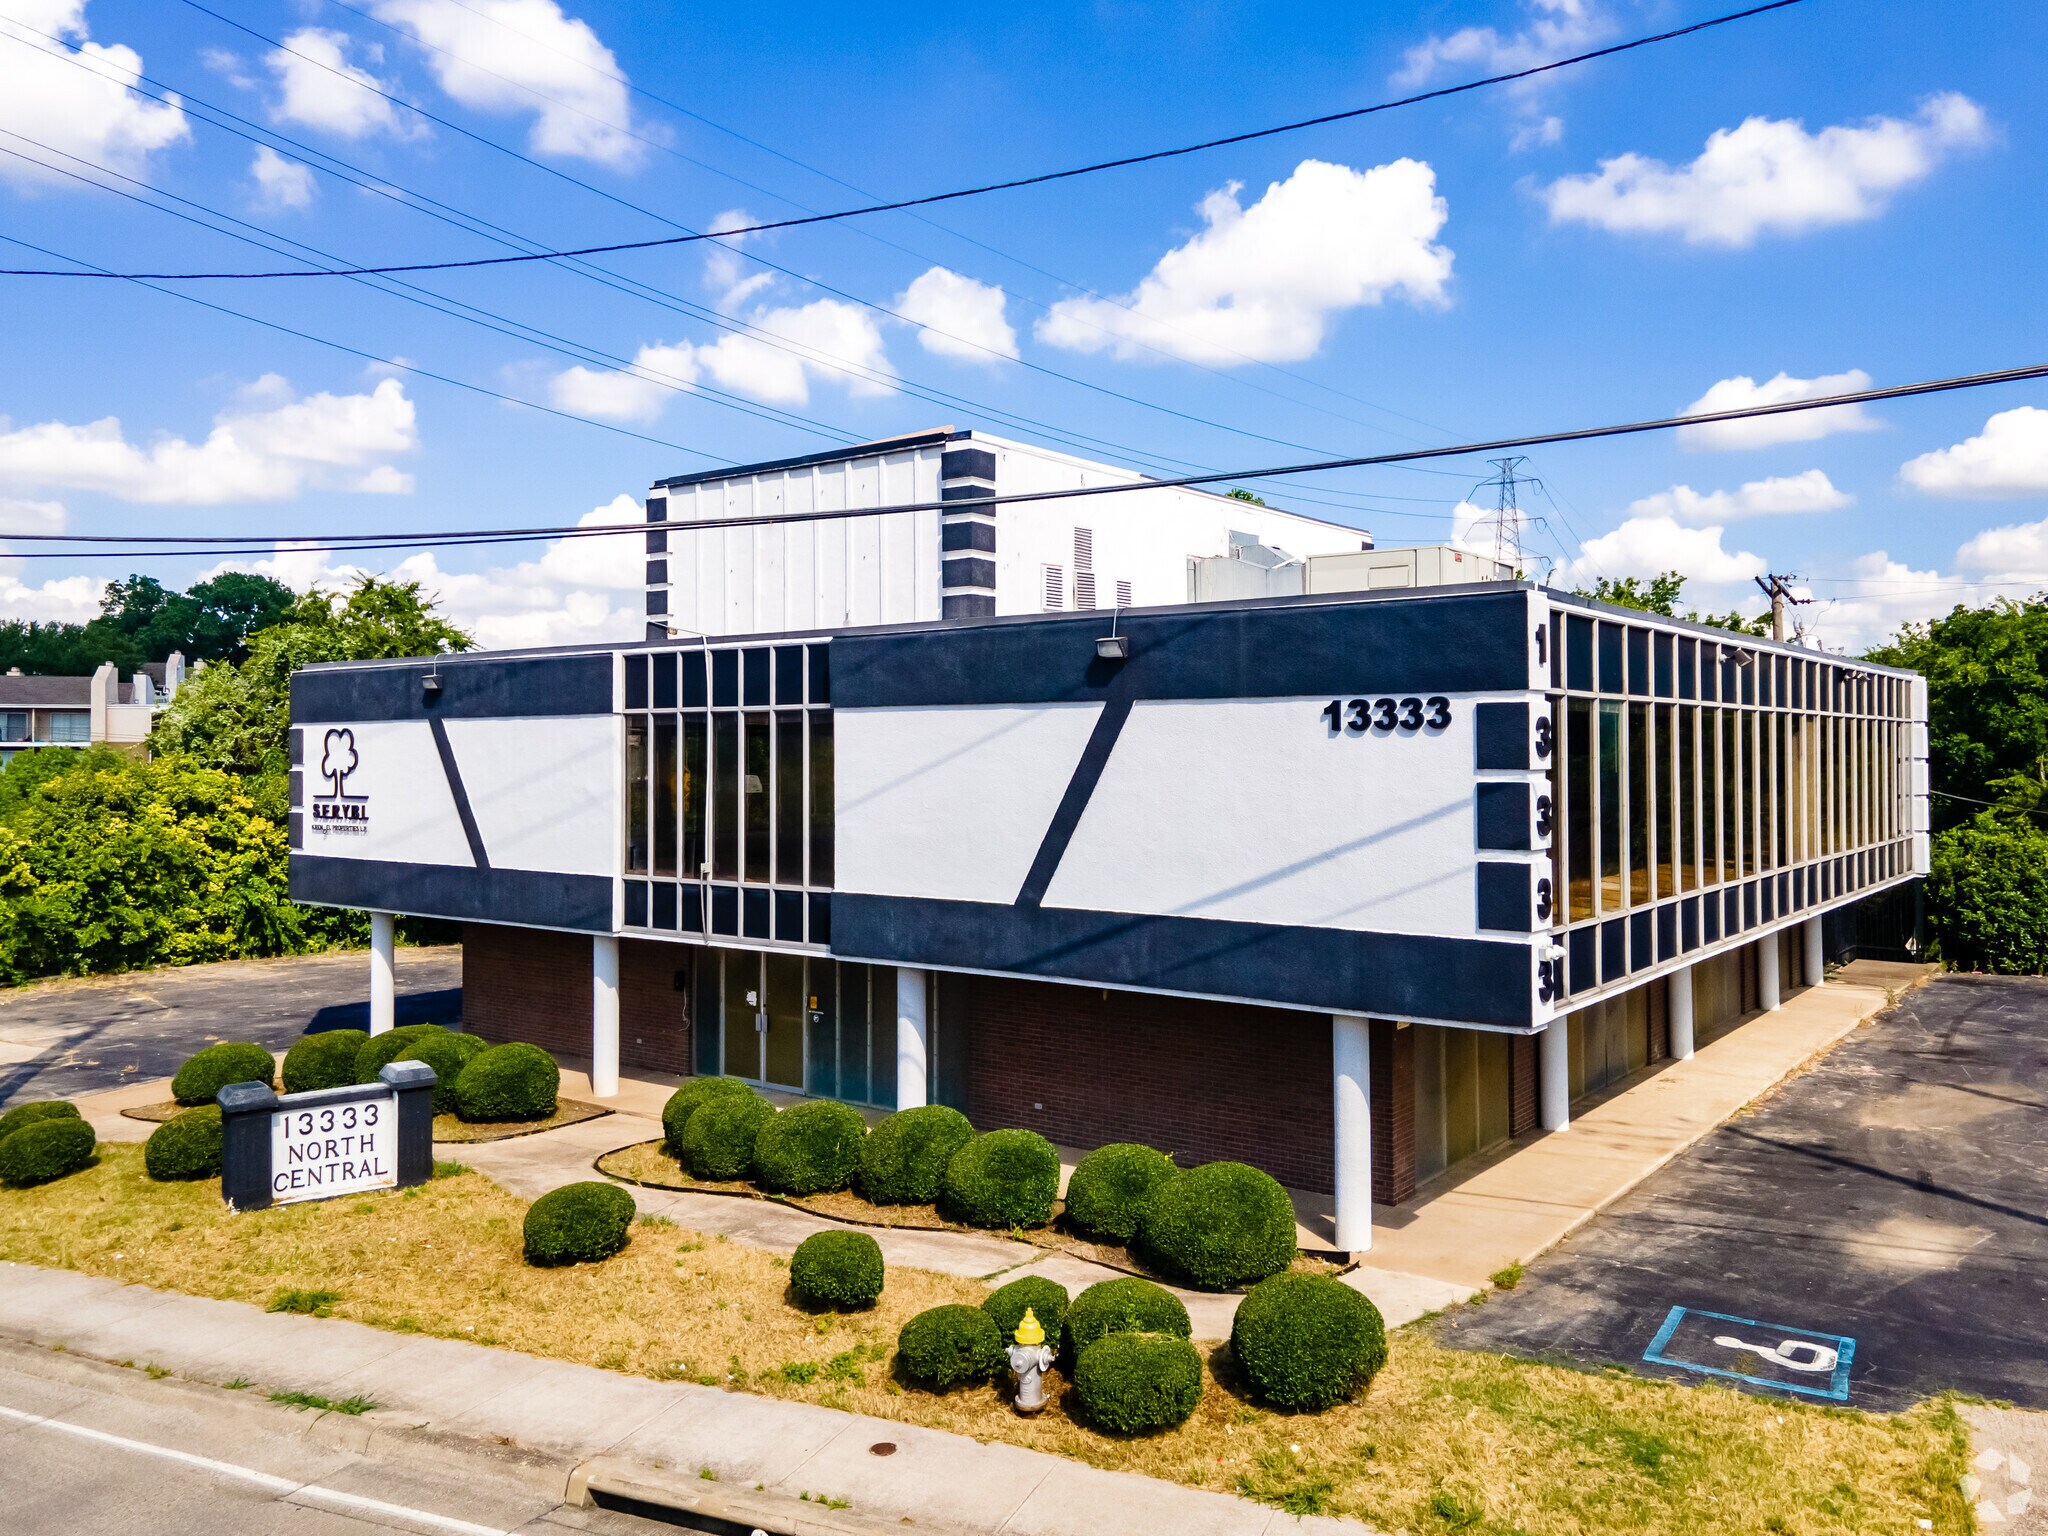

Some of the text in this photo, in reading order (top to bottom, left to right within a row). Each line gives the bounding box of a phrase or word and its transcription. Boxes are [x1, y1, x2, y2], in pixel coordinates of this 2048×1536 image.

[1324, 696, 1452, 731] 13333
[284, 1104, 378, 1138] 13333
[289, 1133, 375, 1164] NORTH
[273, 1157, 388, 1192] CENTRAL
